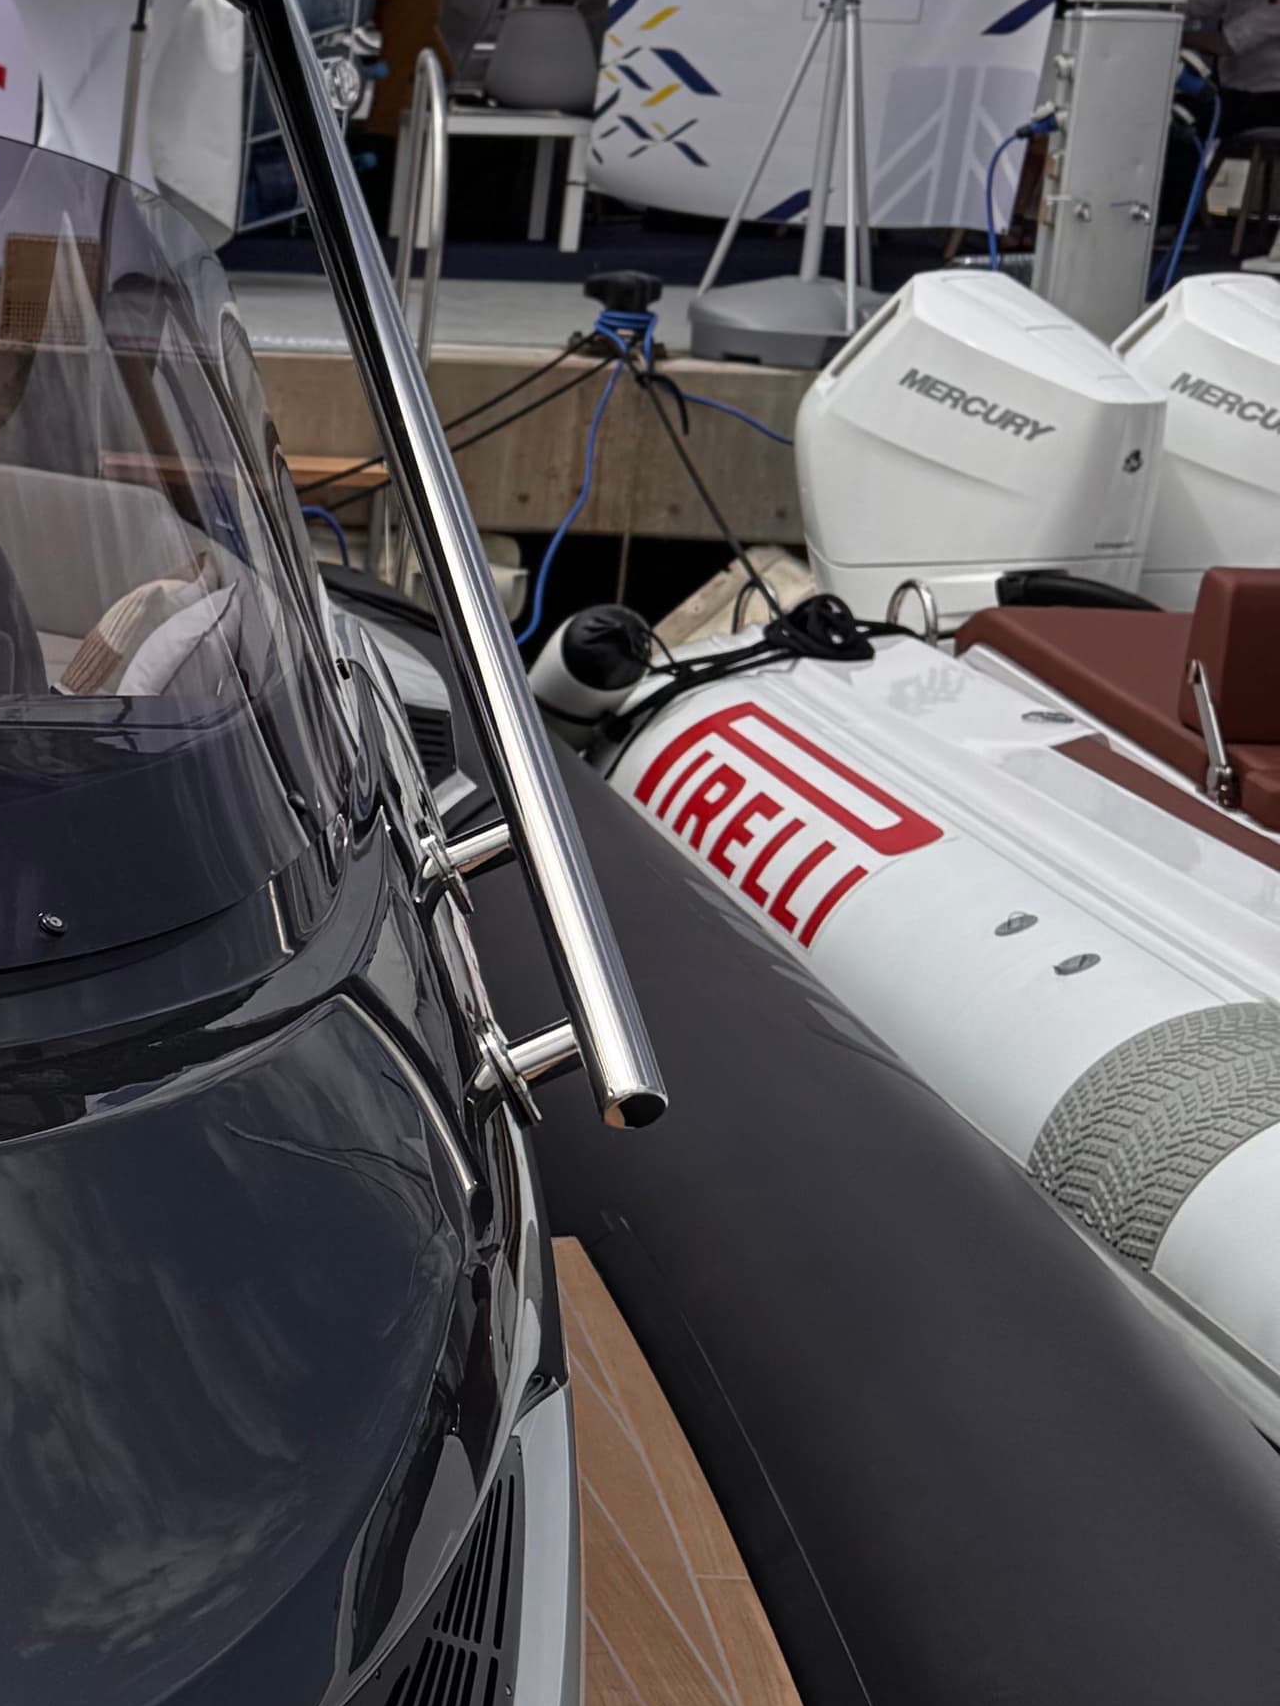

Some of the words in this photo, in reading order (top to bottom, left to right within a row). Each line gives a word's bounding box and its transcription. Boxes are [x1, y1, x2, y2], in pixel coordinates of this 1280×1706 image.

[898, 368, 1057, 442] MERCURY
[1169, 371, 1280, 435] MERCU
[633, 701, 945, 949] PIRELLI
